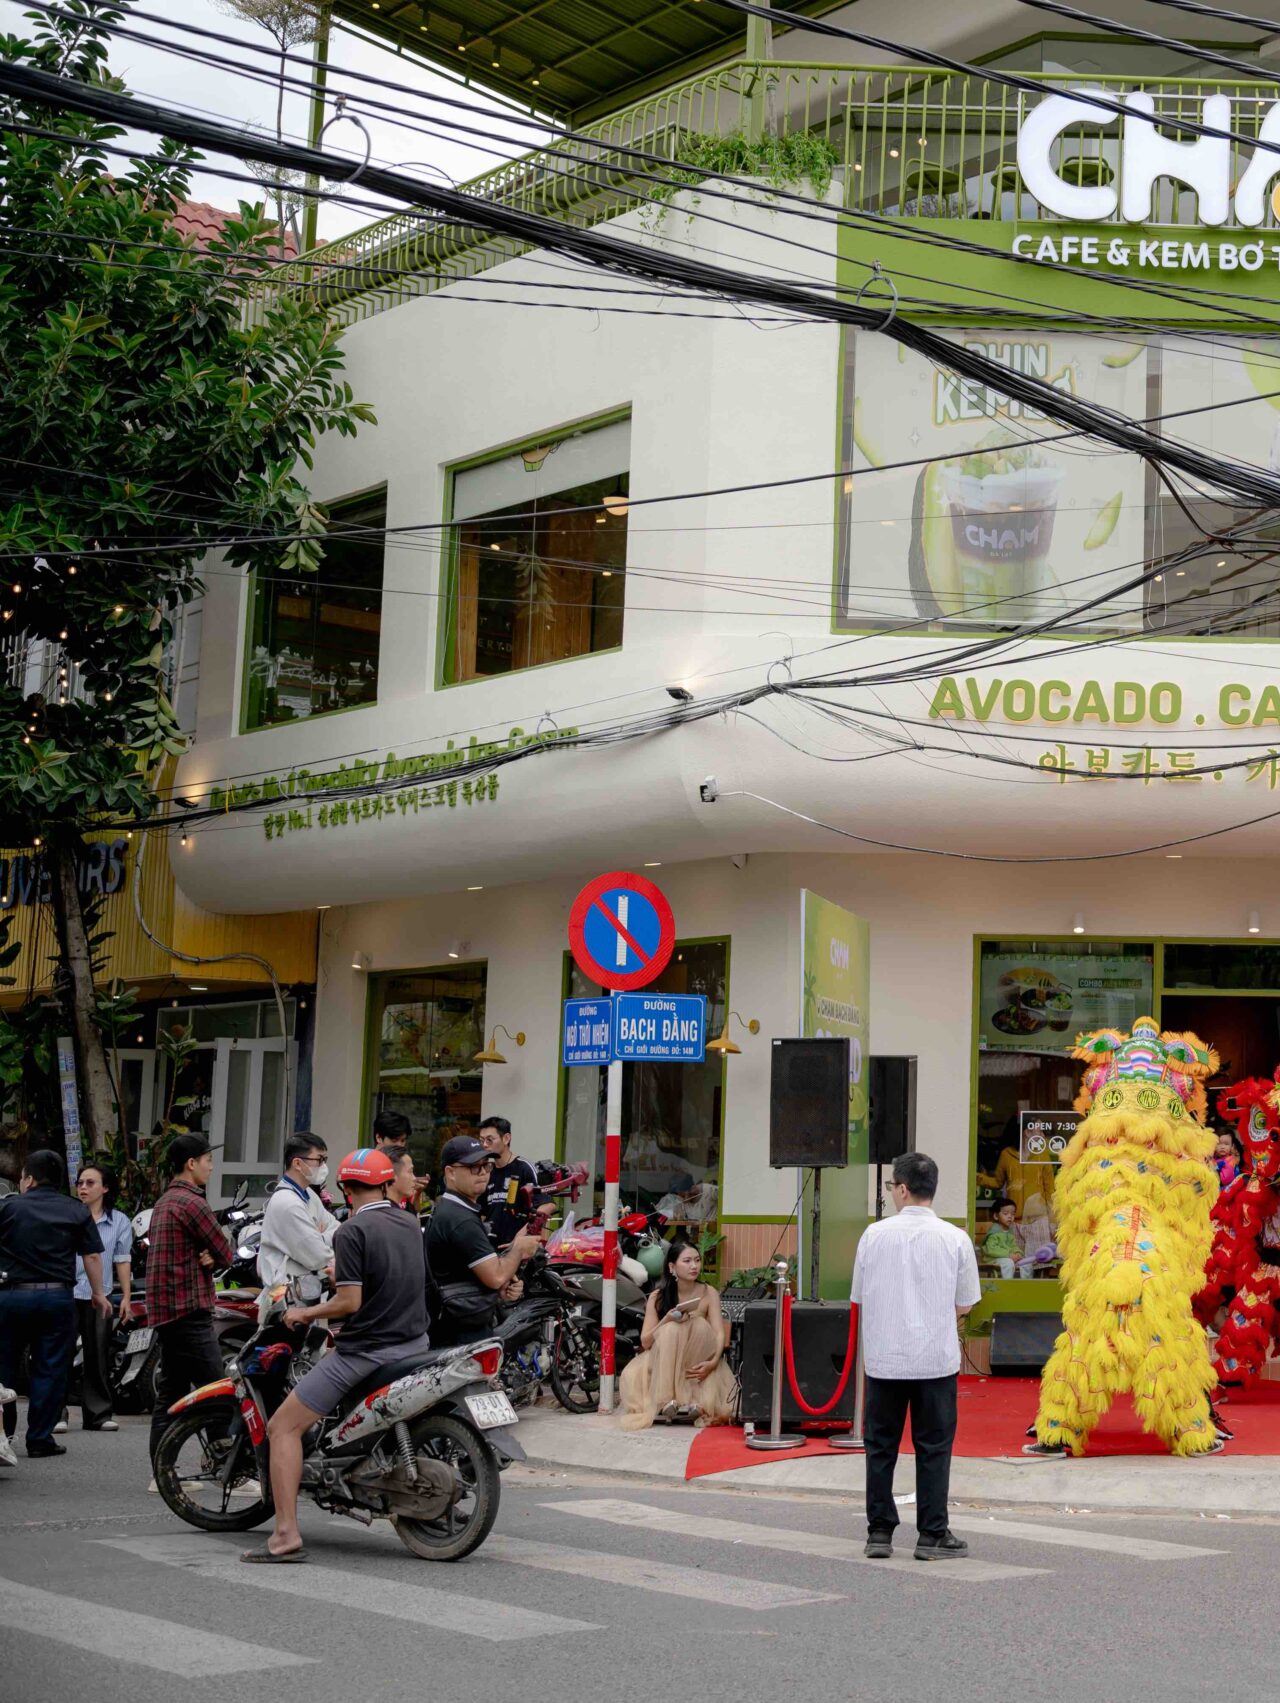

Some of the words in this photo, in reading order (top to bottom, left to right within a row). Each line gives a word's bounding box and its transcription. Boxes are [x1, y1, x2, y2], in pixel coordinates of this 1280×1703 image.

[1012, 234, 1100, 265] CAFE
[1106, 238, 1131, 266] &
[1139, 240, 1211, 269] KEM
[1219, 240, 1265, 271] BƠ
[965, 524, 1039, 550] CHAM
[928, 677, 1182, 723] AVOCADO
[644, 999, 676, 1011] ĐƯỜNG
[620, 1017, 656, 1043] BẠCH
[662, 1012, 698, 1042] ĐẰNG
[1027, 1122, 1052, 1130] OPEN
[1057, 1122, 1076, 1130] 7:30
